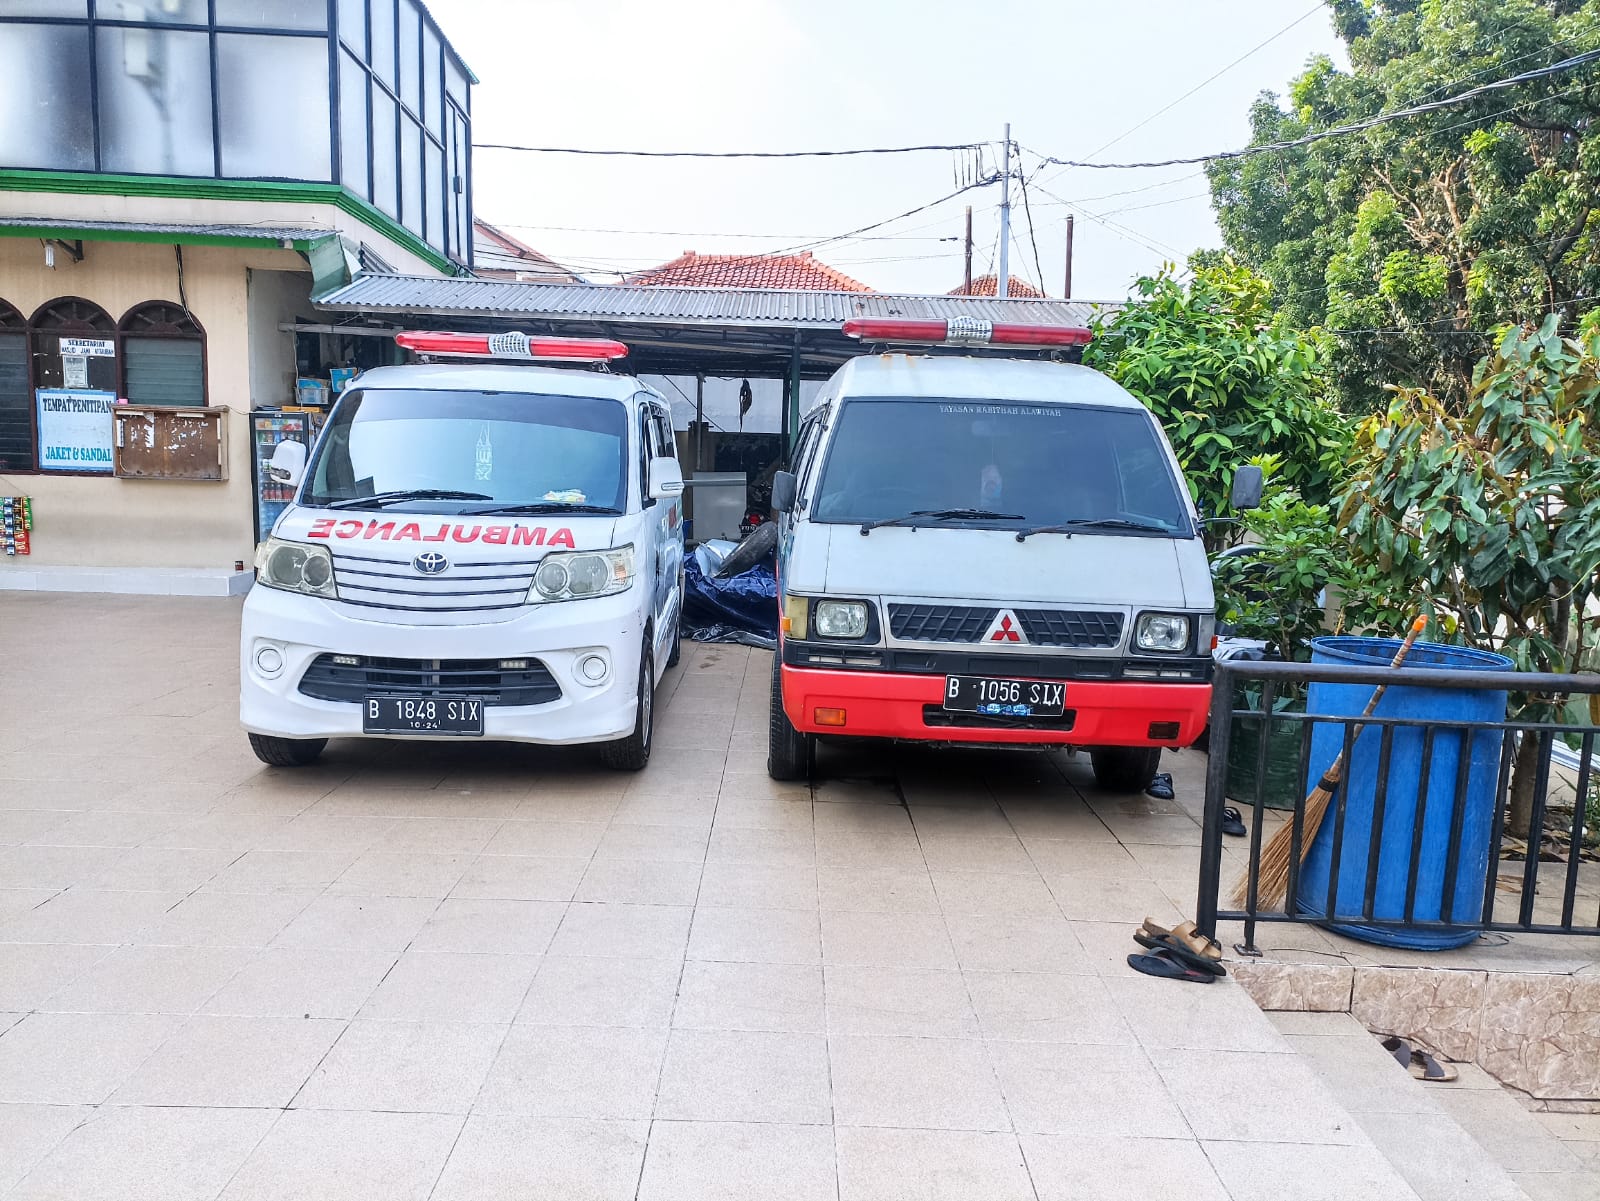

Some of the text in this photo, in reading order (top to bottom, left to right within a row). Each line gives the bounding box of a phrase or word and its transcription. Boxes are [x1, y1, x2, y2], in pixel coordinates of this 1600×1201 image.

[43, 398, 112, 414] TEMPAT PENITIPAN
[46, 446, 112, 462] JAKET & SANDAL
[948, 678, 1062, 706] B 1056 SIX
[369, 700, 478, 720] B 1848 SIX
